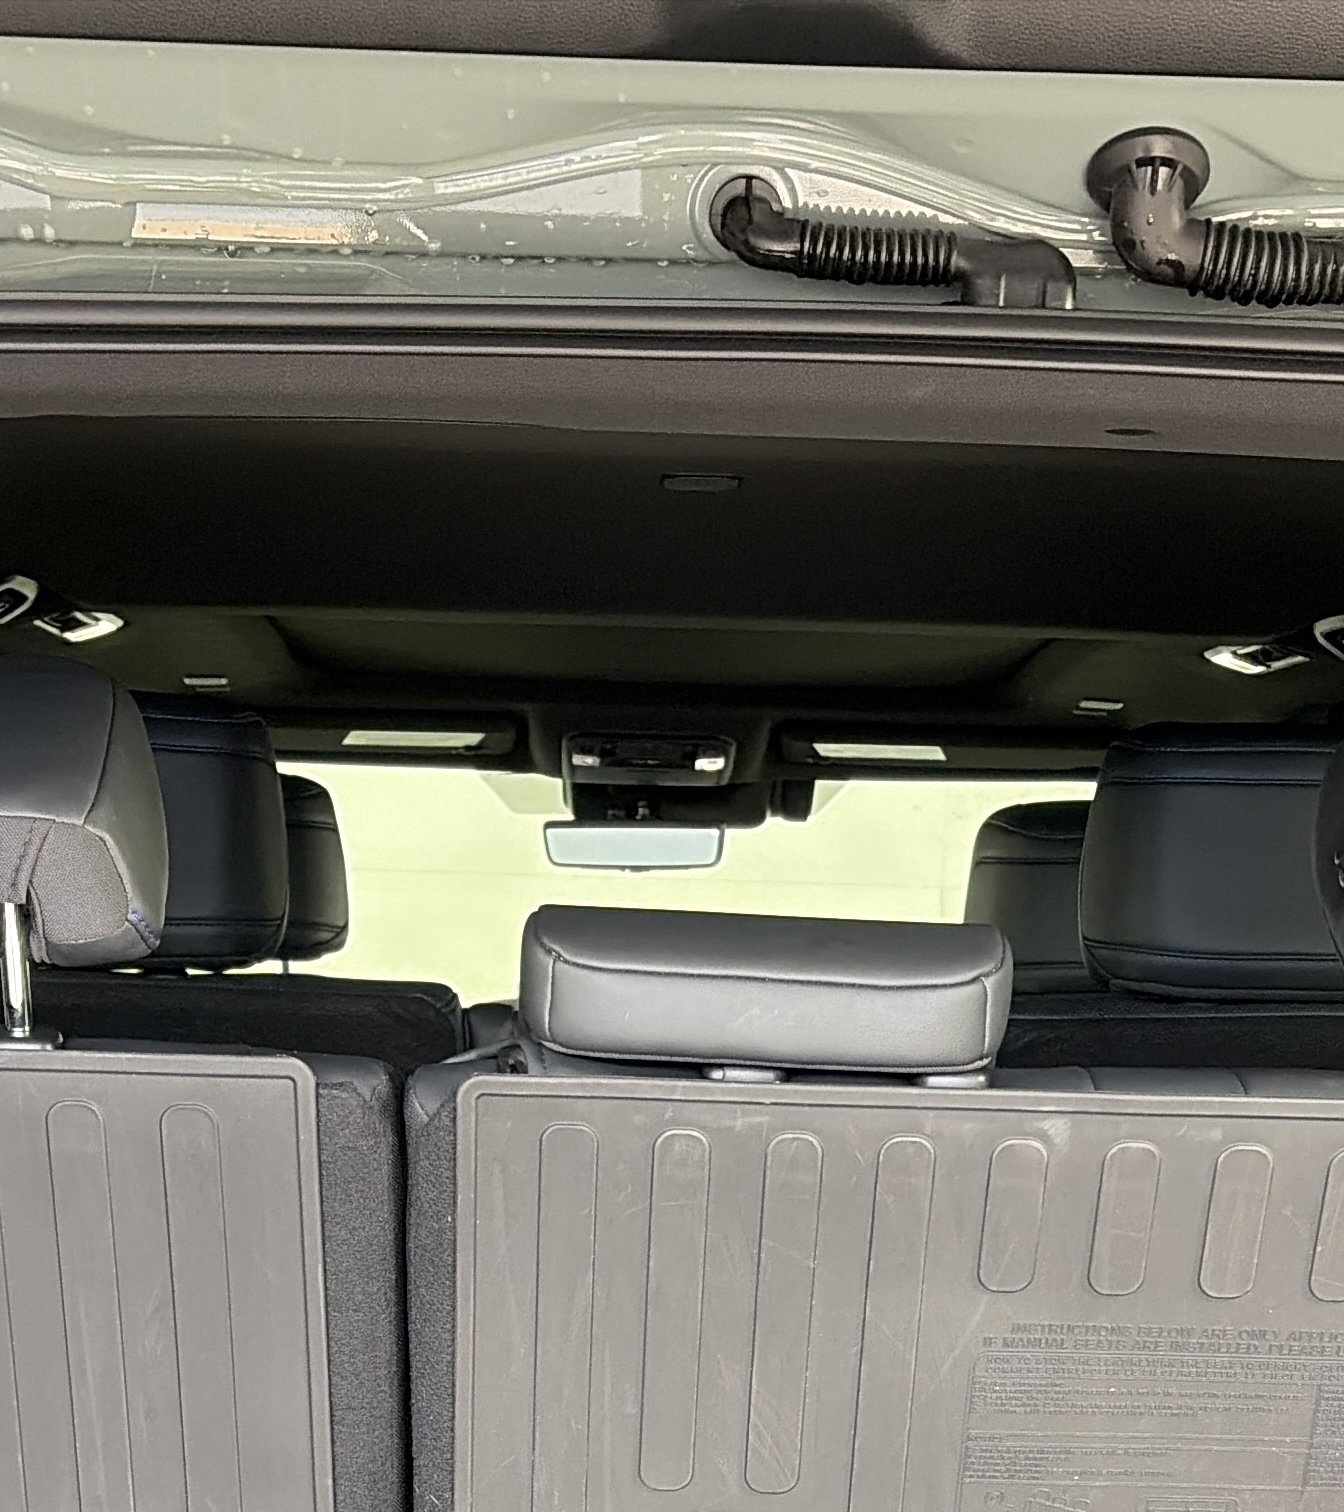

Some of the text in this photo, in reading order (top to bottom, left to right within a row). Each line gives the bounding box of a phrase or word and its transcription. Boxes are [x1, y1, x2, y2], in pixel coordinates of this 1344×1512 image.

[1011, 1323, 1132, 1337] INSTRUCTIONS
[1137, 1325, 1197, 1339] BELOW
[1201, 1326, 1235, 1340] ARE
[1238, 1328, 1278, 1342] ONLY
[983, 1336, 1000, 1347] IF
[1002, 1336, 1069, 1349] MANUAL
[1073, 1338, 1128, 1351] SEATS
[1132, 1339, 1165, 1351] ARE
[1268, 1343, 1331, 1356] PLEASE
